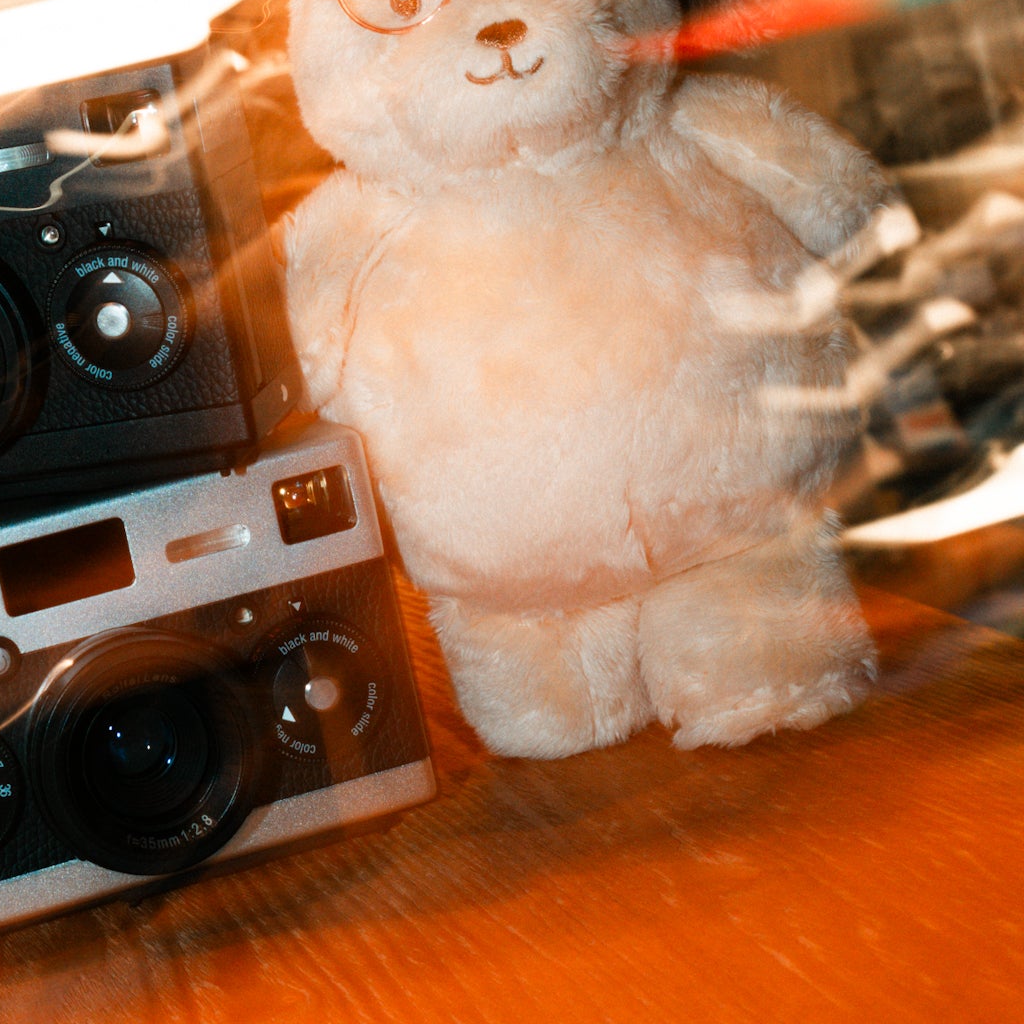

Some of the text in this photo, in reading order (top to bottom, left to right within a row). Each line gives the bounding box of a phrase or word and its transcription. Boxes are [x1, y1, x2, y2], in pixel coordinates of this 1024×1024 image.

[75, 256, 159, 284] black and white
[55, 322, 113, 381] color negative
[149, 315, 179, 369] color slide
[278, 630, 359, 656] black and white
[350, 682, 378, 737] color slide
[290, 739, 316, 754] color
[0, 783, 12, 798] 36
